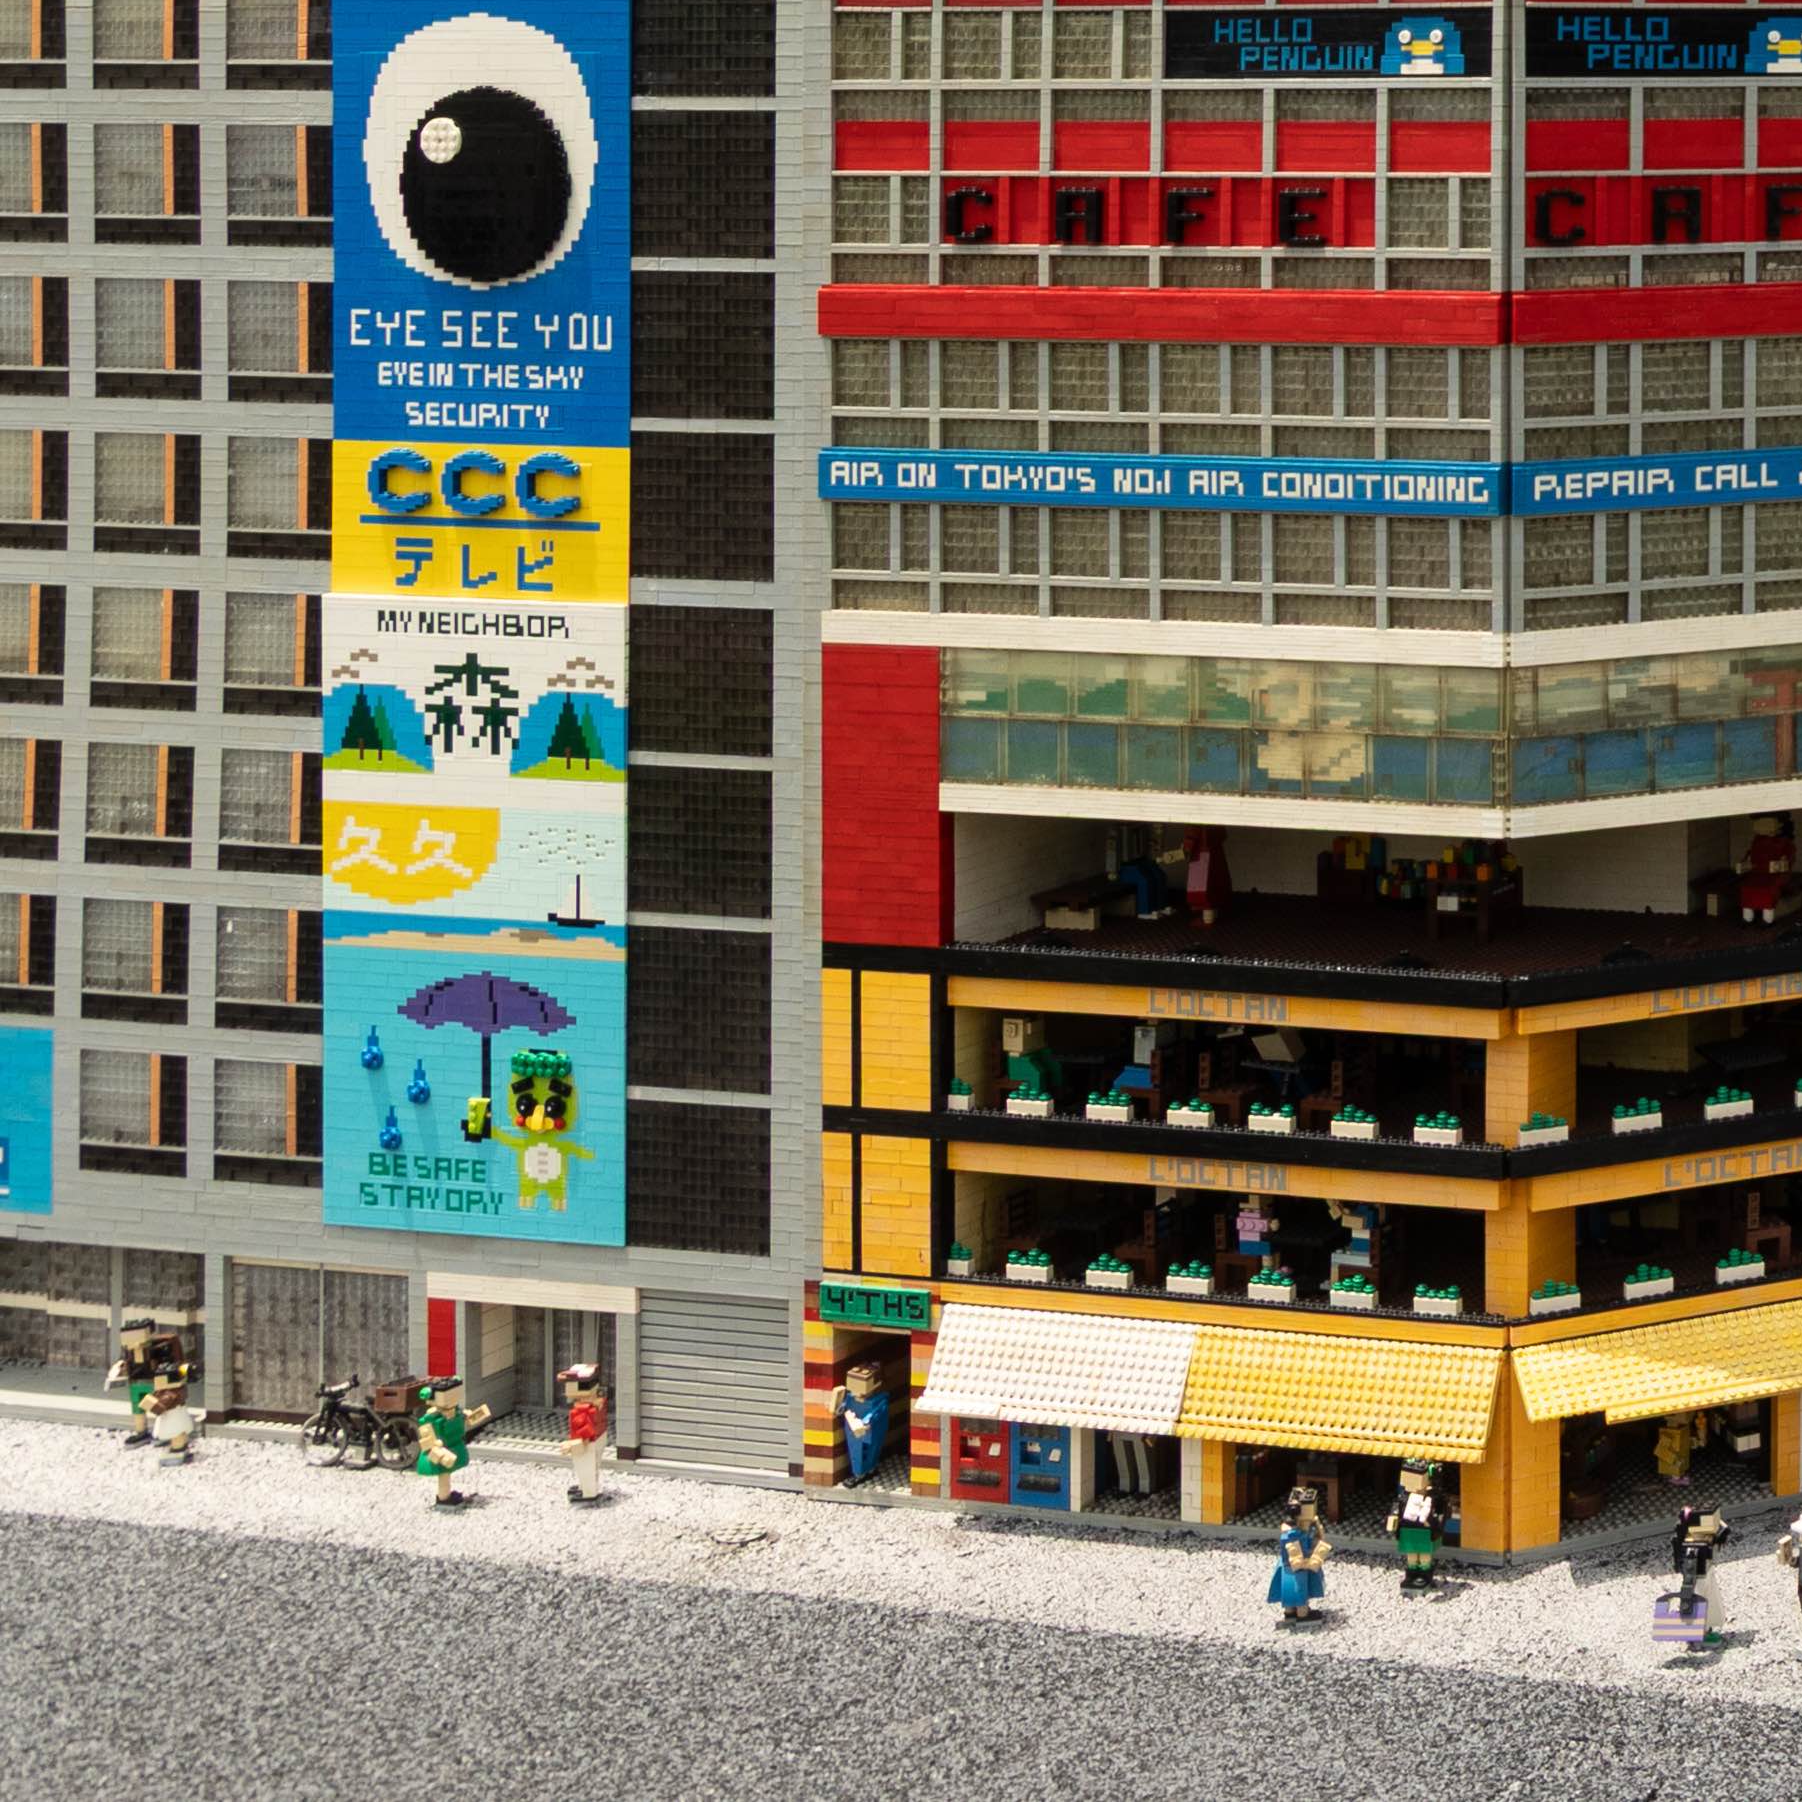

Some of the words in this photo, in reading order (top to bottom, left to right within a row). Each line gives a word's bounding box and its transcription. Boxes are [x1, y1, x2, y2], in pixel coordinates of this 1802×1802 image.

[1214, 17, 1312, 44] HELLO
[1557, 15, 1669, 43] HELLO
[1240, 44, 1374, 71] PENGUIN
[1587, 43, 1738, 70] PENGUIN
[945, 186, 1328, 247] CAFE
[350, 308, 426, 347] EYE
[442, 310, 519, 349] SEE
[534, 312, 613, 351] YOU
[378, 361, 424, 387] EYE
[428, 362, 453, 388] IN
[458, 363, 520, 389] THE
[525, 365, 584, 390] SKY
[405, 401, 550, 429] SECURITY
[367, 447, 583, 520] CCC
[830, 460, 884, 487] AIR
[897, 462, 938, 489] ON
[955, 463, 1096, 494] TOKYO'S
[1189, 469, 1245, 497] AIR
[1262, 471, 1490, 504] CONDITIONING
[1533, 467, 1675, 501] REPAIR
[1695, 462, 1779, 493] CALL
[394, 536, 555, 594] テレビ
[377, 609, 412, 633] MY
[418, 610, 570, 639] NEIGHBOR
[424, 652, 520, 756] 森
[368, 1152, 407, 1177] BE
[414, 1155, 487, 1183] SAFE
[359, 1182, 440, 1210] STAY
[446, 1188, 504, 1215] DRY
